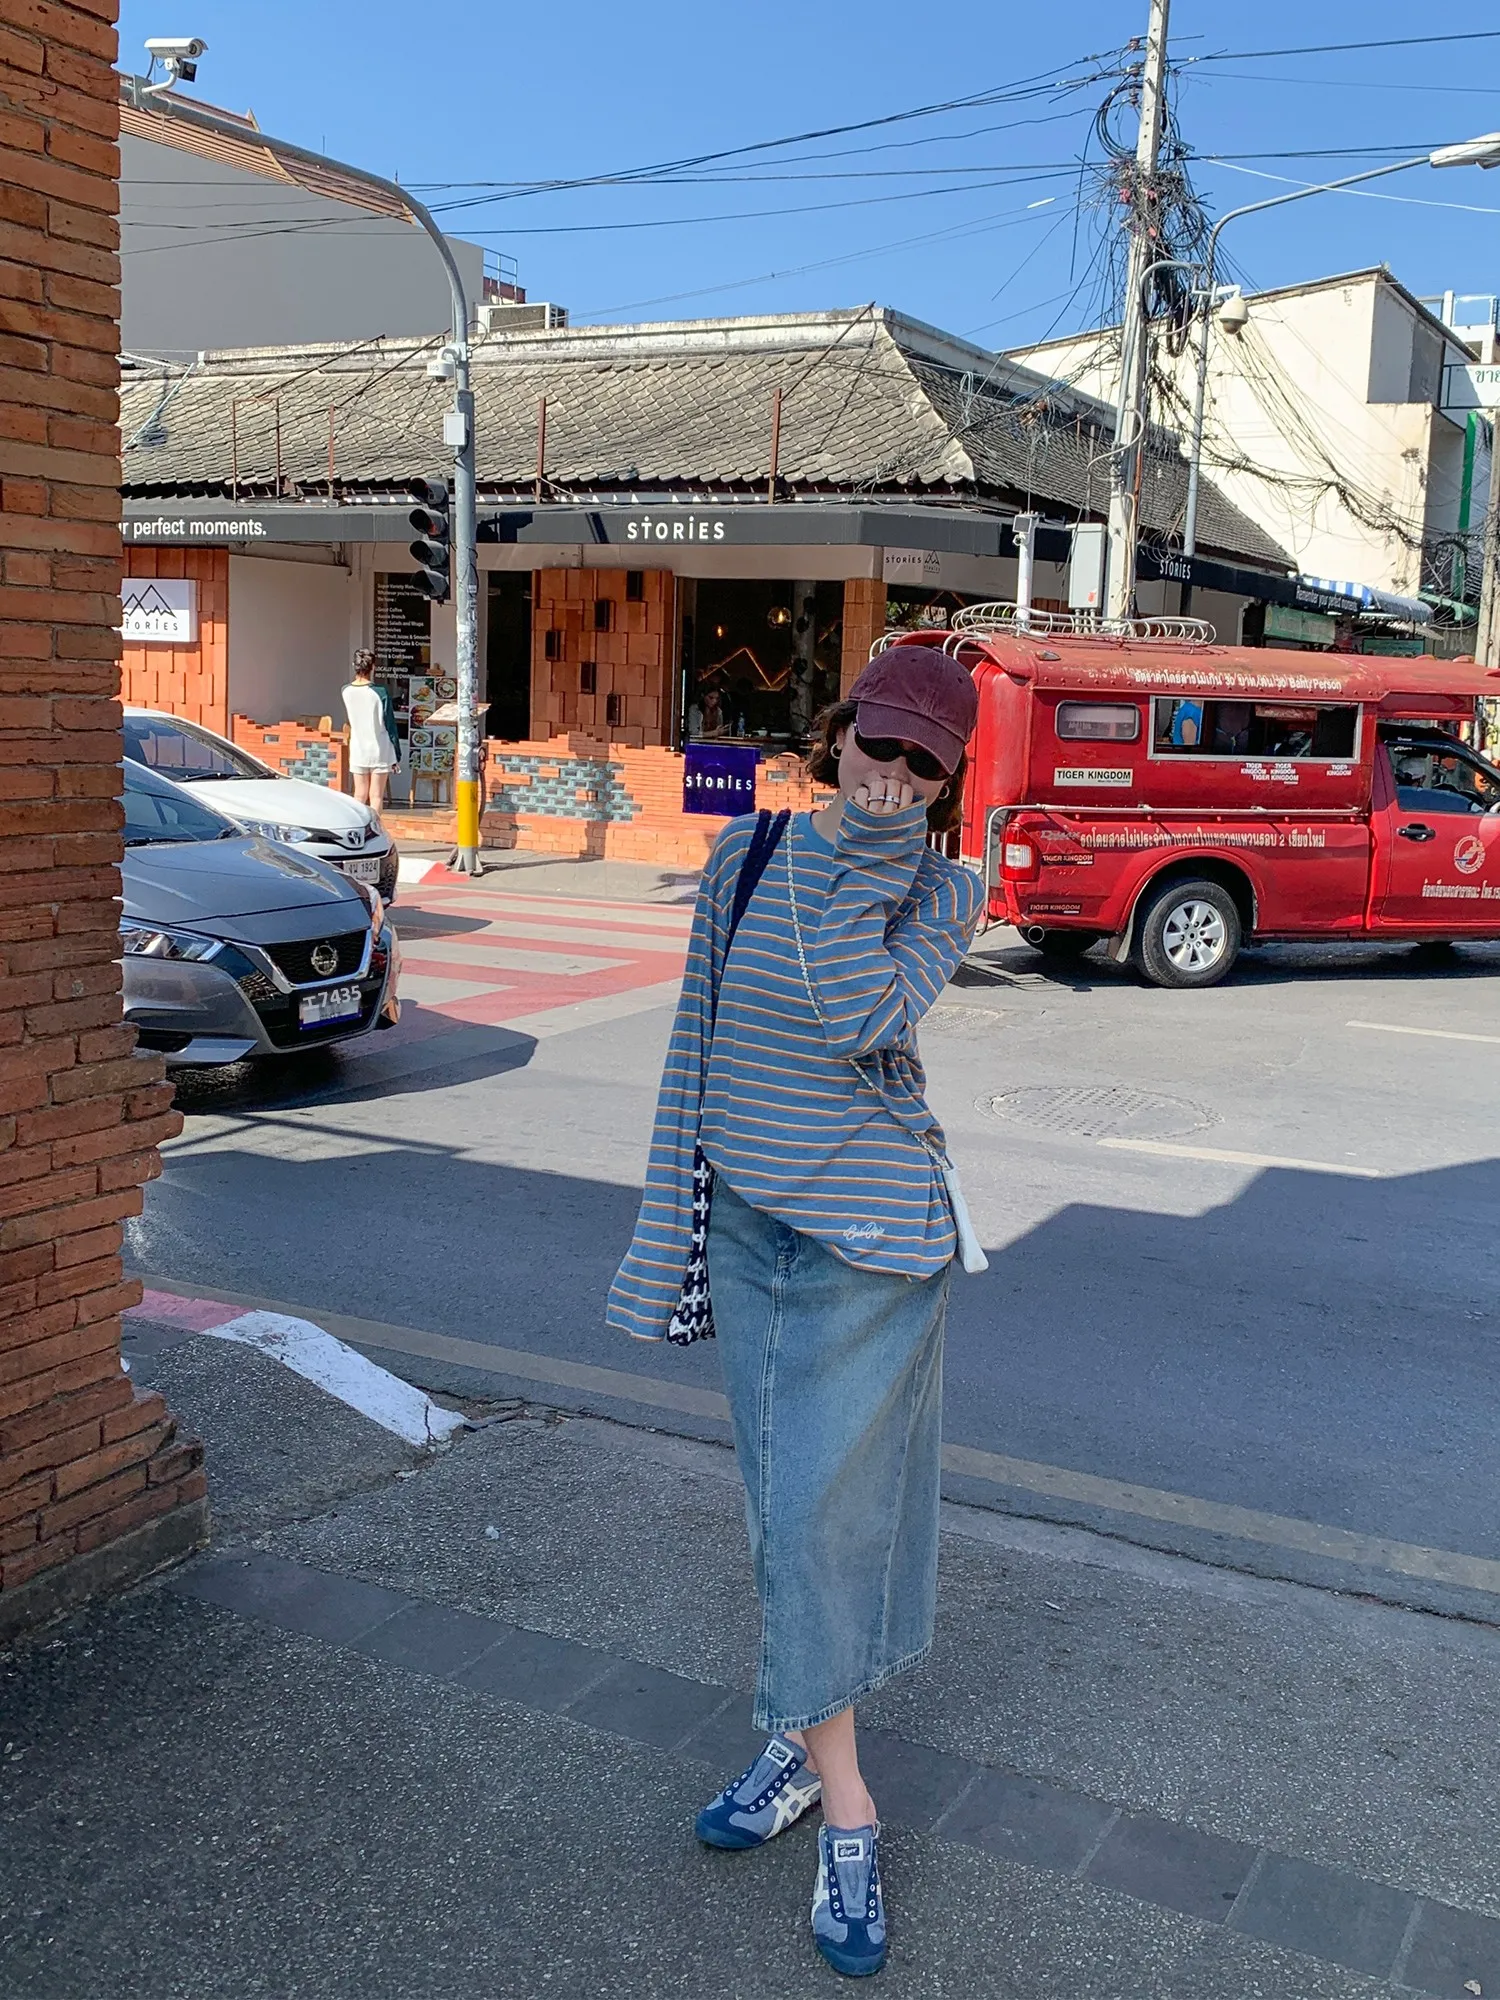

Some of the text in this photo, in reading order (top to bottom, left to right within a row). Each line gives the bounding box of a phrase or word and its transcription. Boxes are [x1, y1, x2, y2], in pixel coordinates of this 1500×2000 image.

[133, 517, 185, 539] perfect
[189, 518, 267, 536] moments.
[685, 772, 752, 790] STORIES
[1056, 770, 1131, 780] TIGER KINGDOM
